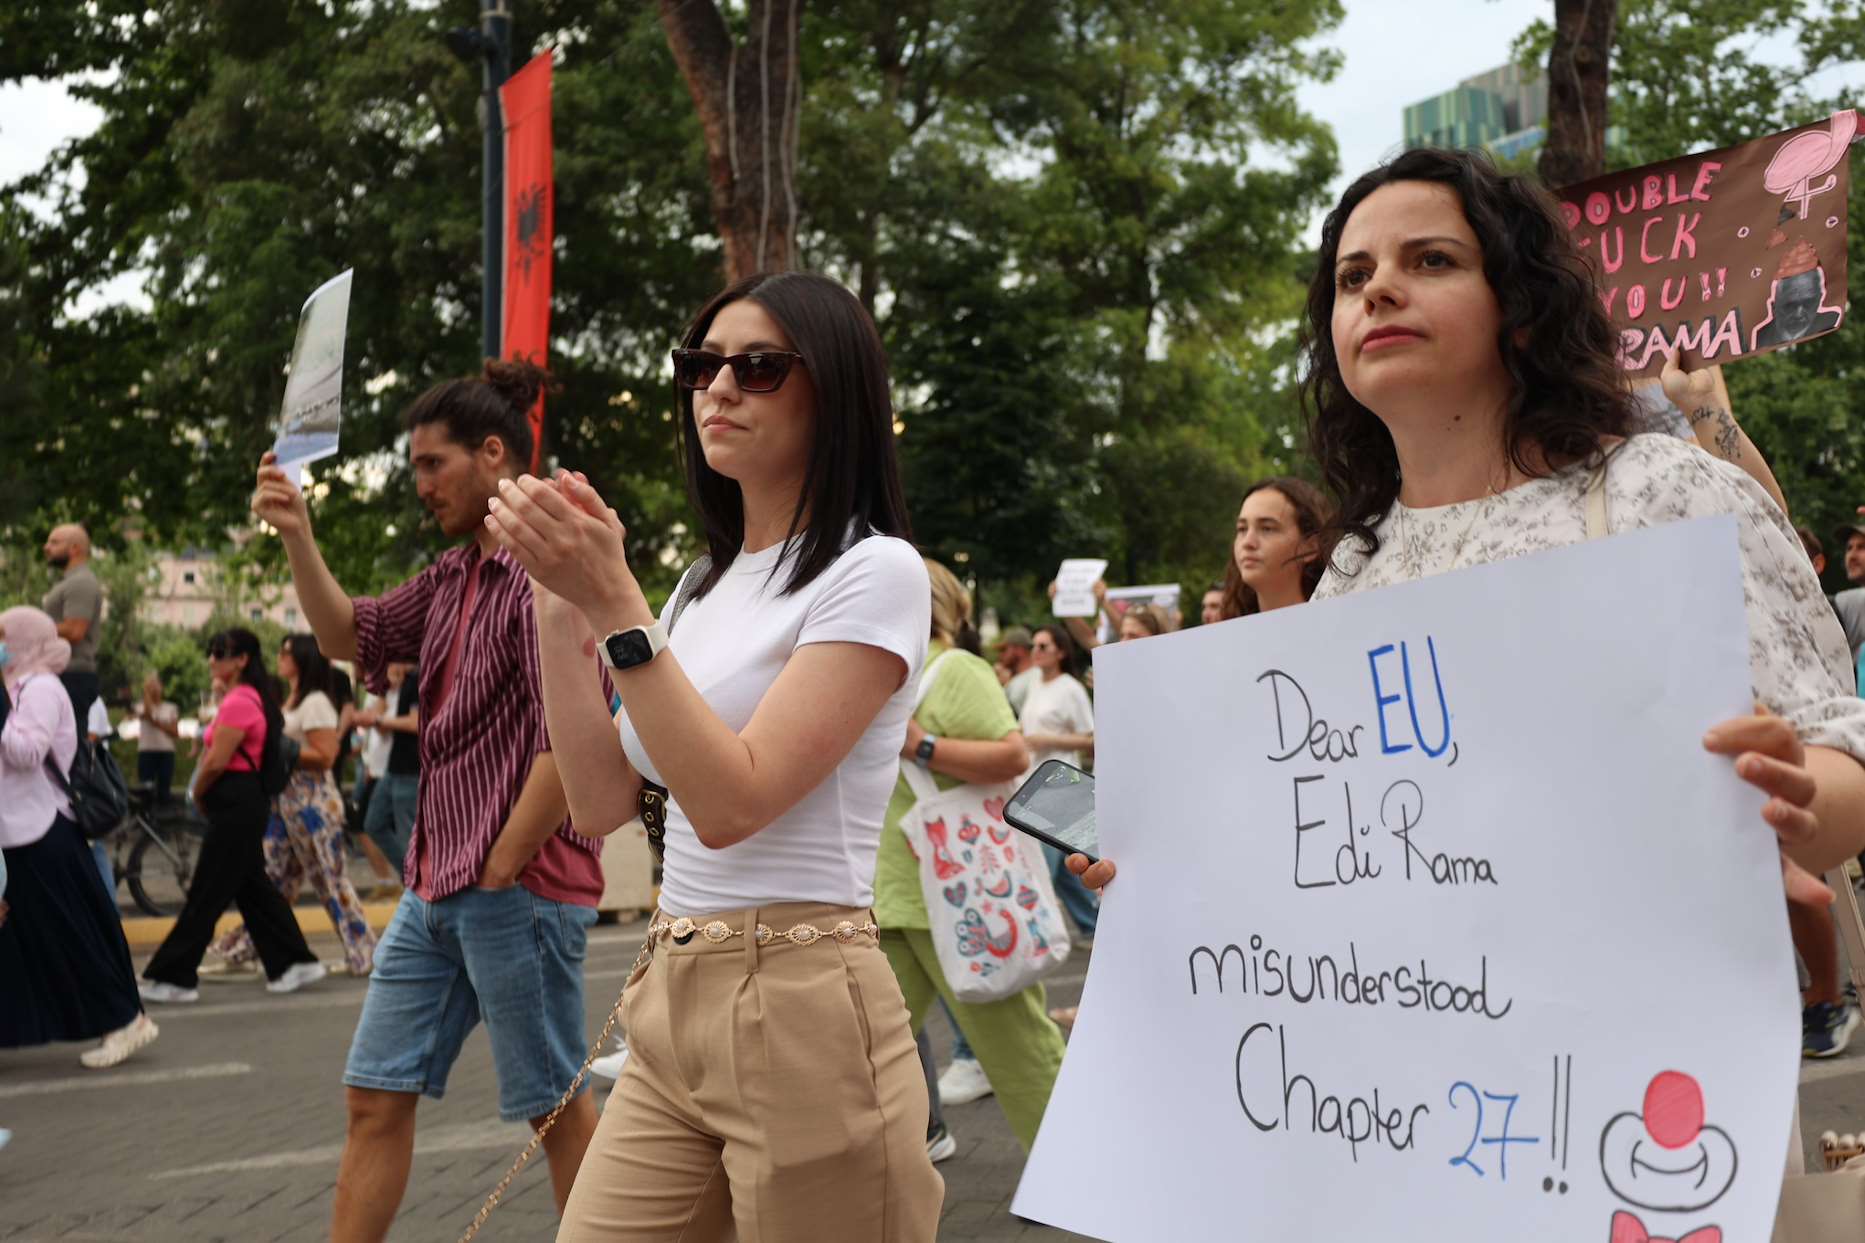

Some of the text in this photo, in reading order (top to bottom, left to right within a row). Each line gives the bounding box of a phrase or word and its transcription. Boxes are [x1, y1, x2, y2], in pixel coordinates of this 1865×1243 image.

[1577, 212, 1701, 274] UCK
[1615, 309, 1744, 371] RAMA
[1256, 634, 1460, 768] Dear EU,
[1292, 773, 1499, 890] Edi Rama
[1188, 933, 1513, 1021] misunderstood
[1235, 1021, 1431, 1164] Chapter
